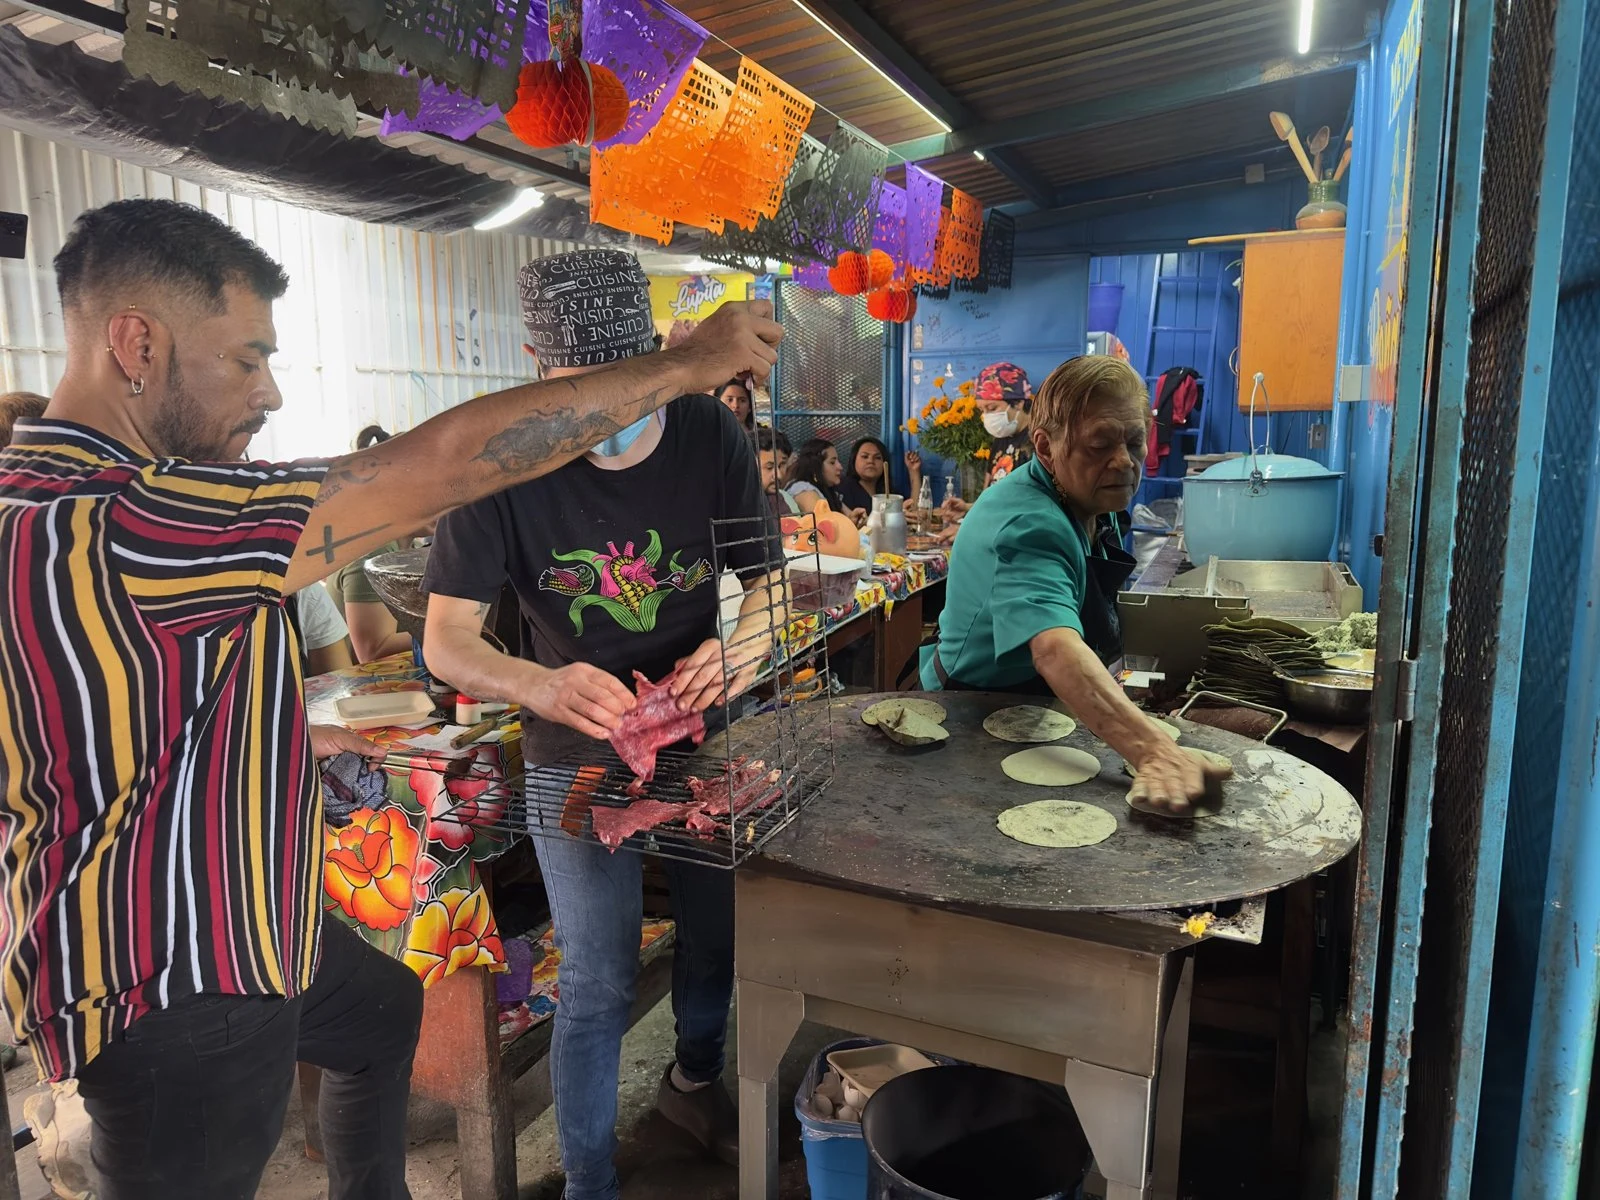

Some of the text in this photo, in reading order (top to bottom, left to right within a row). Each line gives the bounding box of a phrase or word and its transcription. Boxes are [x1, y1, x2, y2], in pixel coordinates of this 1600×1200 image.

[550, 257, 617, 274] CUISINE
[576, 270, 640, 289] CUISINE
[607, 286, 635, 294] CUISINE
[669, 278, 727, 318] Lupita
[560, 307, 627, 326] CUISINE
[588, 317, 644, 342] CUISINE
[573, 343, 607, 353] CUISINE
[608, 336, 637, 348] CUISINE
[548, 350, 618, 367] CUISINE
